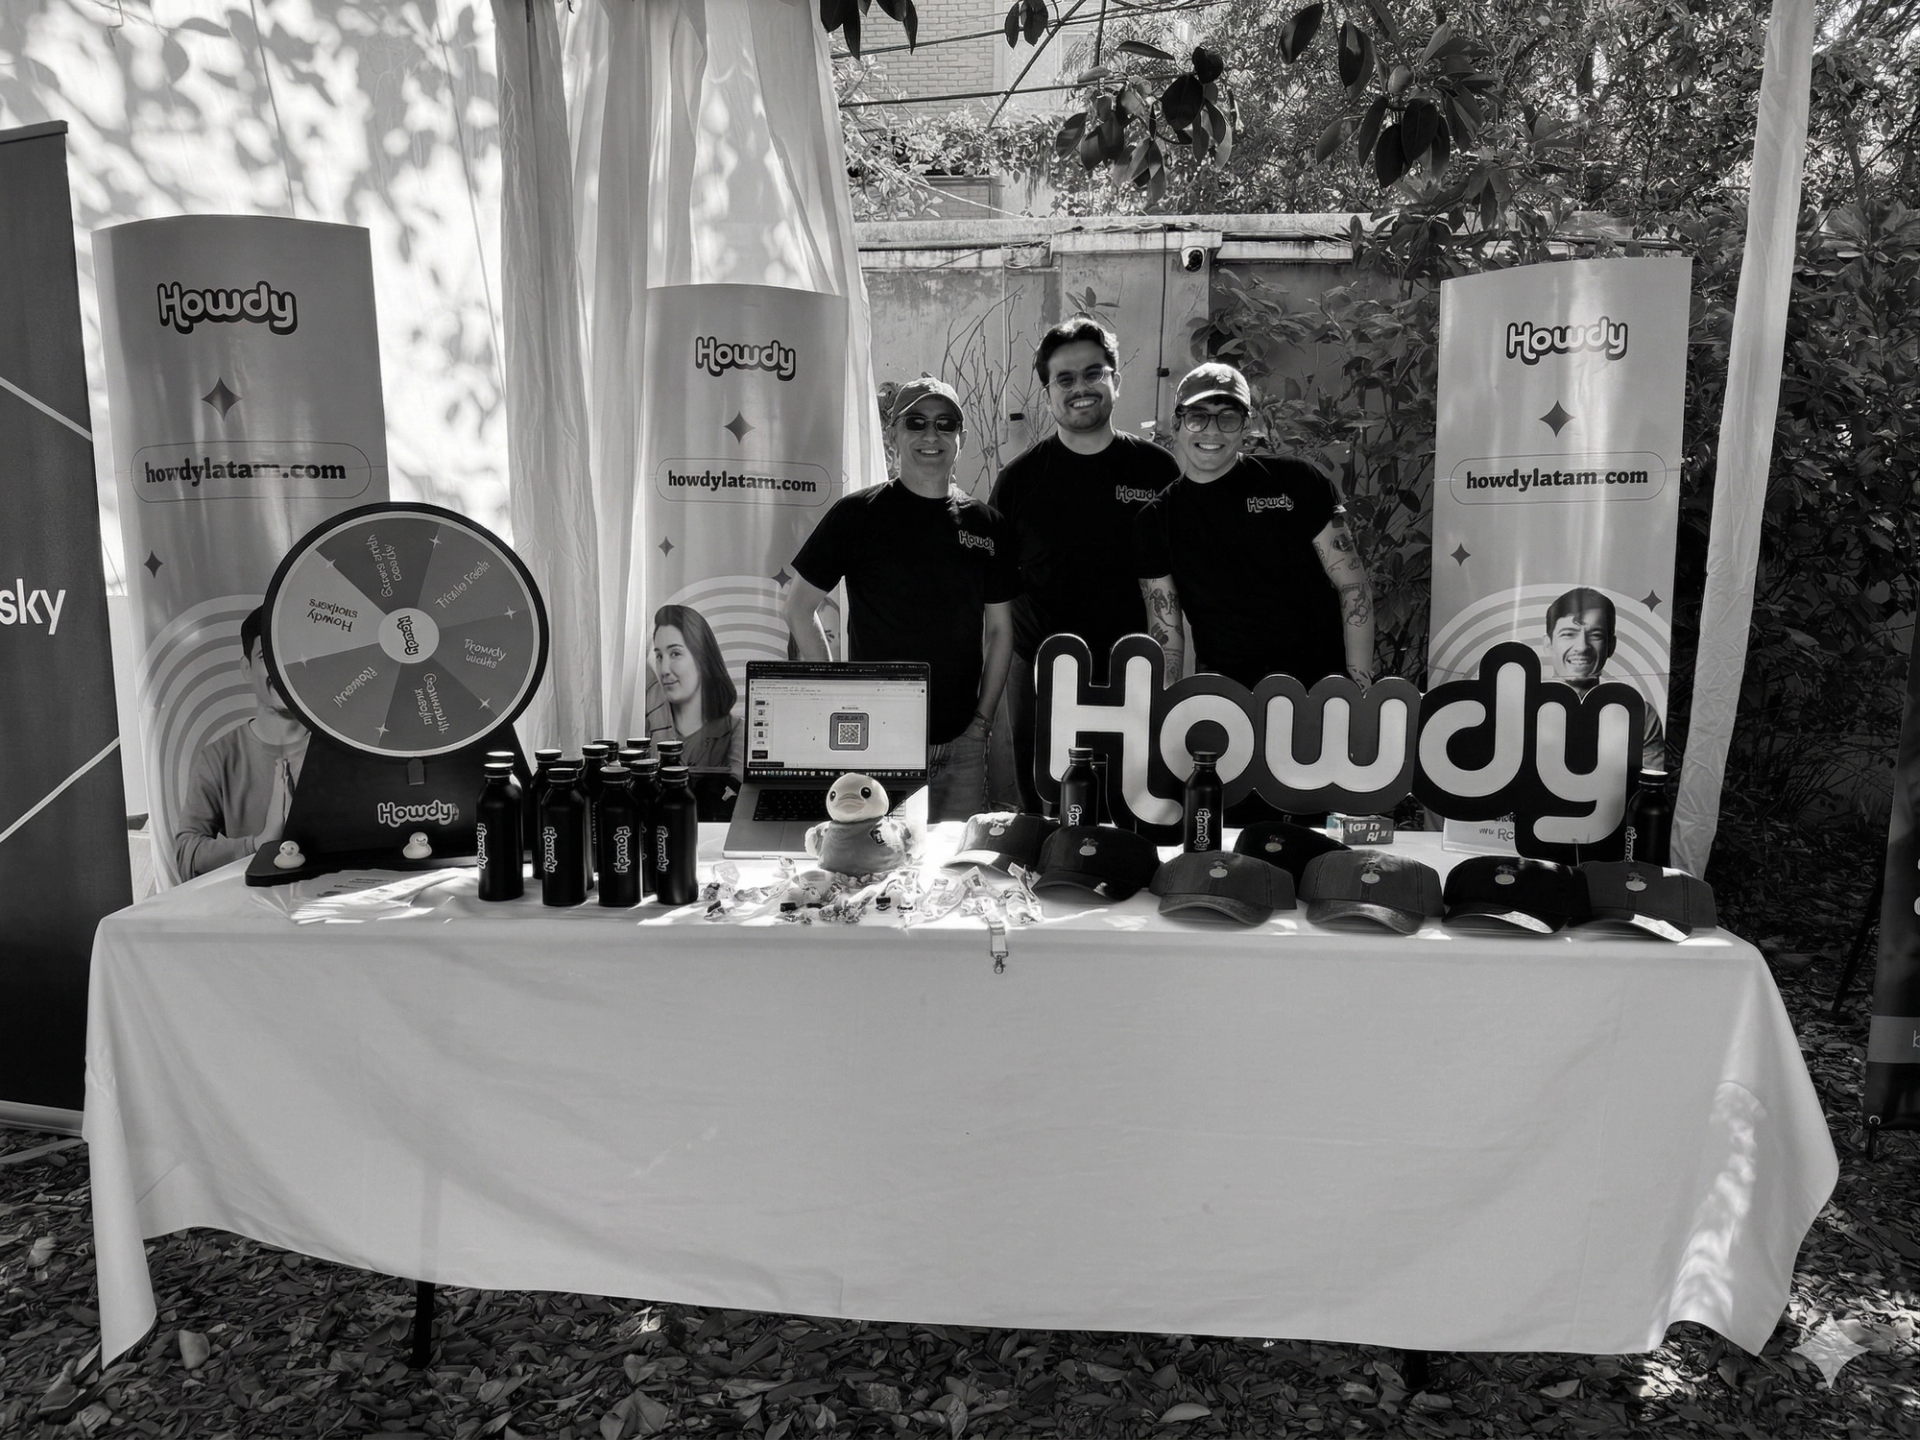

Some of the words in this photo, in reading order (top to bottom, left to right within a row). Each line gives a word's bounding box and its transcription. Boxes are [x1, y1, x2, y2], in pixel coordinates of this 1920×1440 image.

[157, 280, 298, 335] Howdy
[695, 336, 796, 381] Howdy
[1506, 316, 1629, 365] Howdy
[144, 457, 346, 487] howdylatam.com
[667, 470, 817, 492] howdylatam.com
[1116, 485, 1157, 503] Howd
[1466, 468, 1649, 492] howdylatam.com
[0, 578, 67, 636] sky
[1035, 633, 1646, 861] Howdy
[377, 799, 453, 828] Howdy
[613, 825, 632, 874] Howdy
